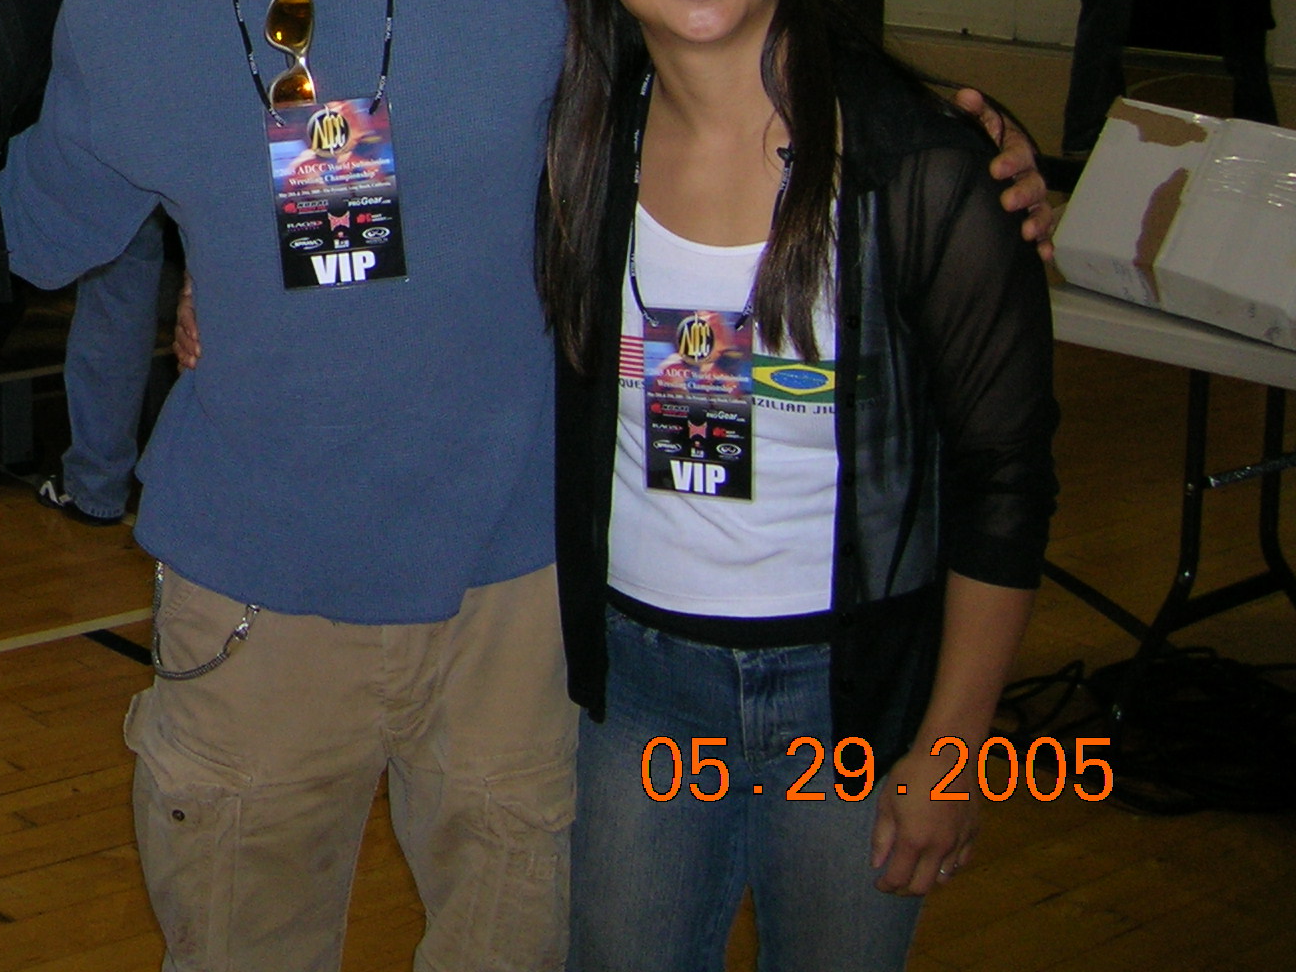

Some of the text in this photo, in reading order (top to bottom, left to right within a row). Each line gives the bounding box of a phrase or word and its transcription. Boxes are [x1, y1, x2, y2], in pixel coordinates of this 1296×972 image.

[297, 163, 326, 175] ADCC
[311, 250, 376, 285] VIP
[666, 368, 692, 378] ADCC
[670, 459, 726, 494] VIP
